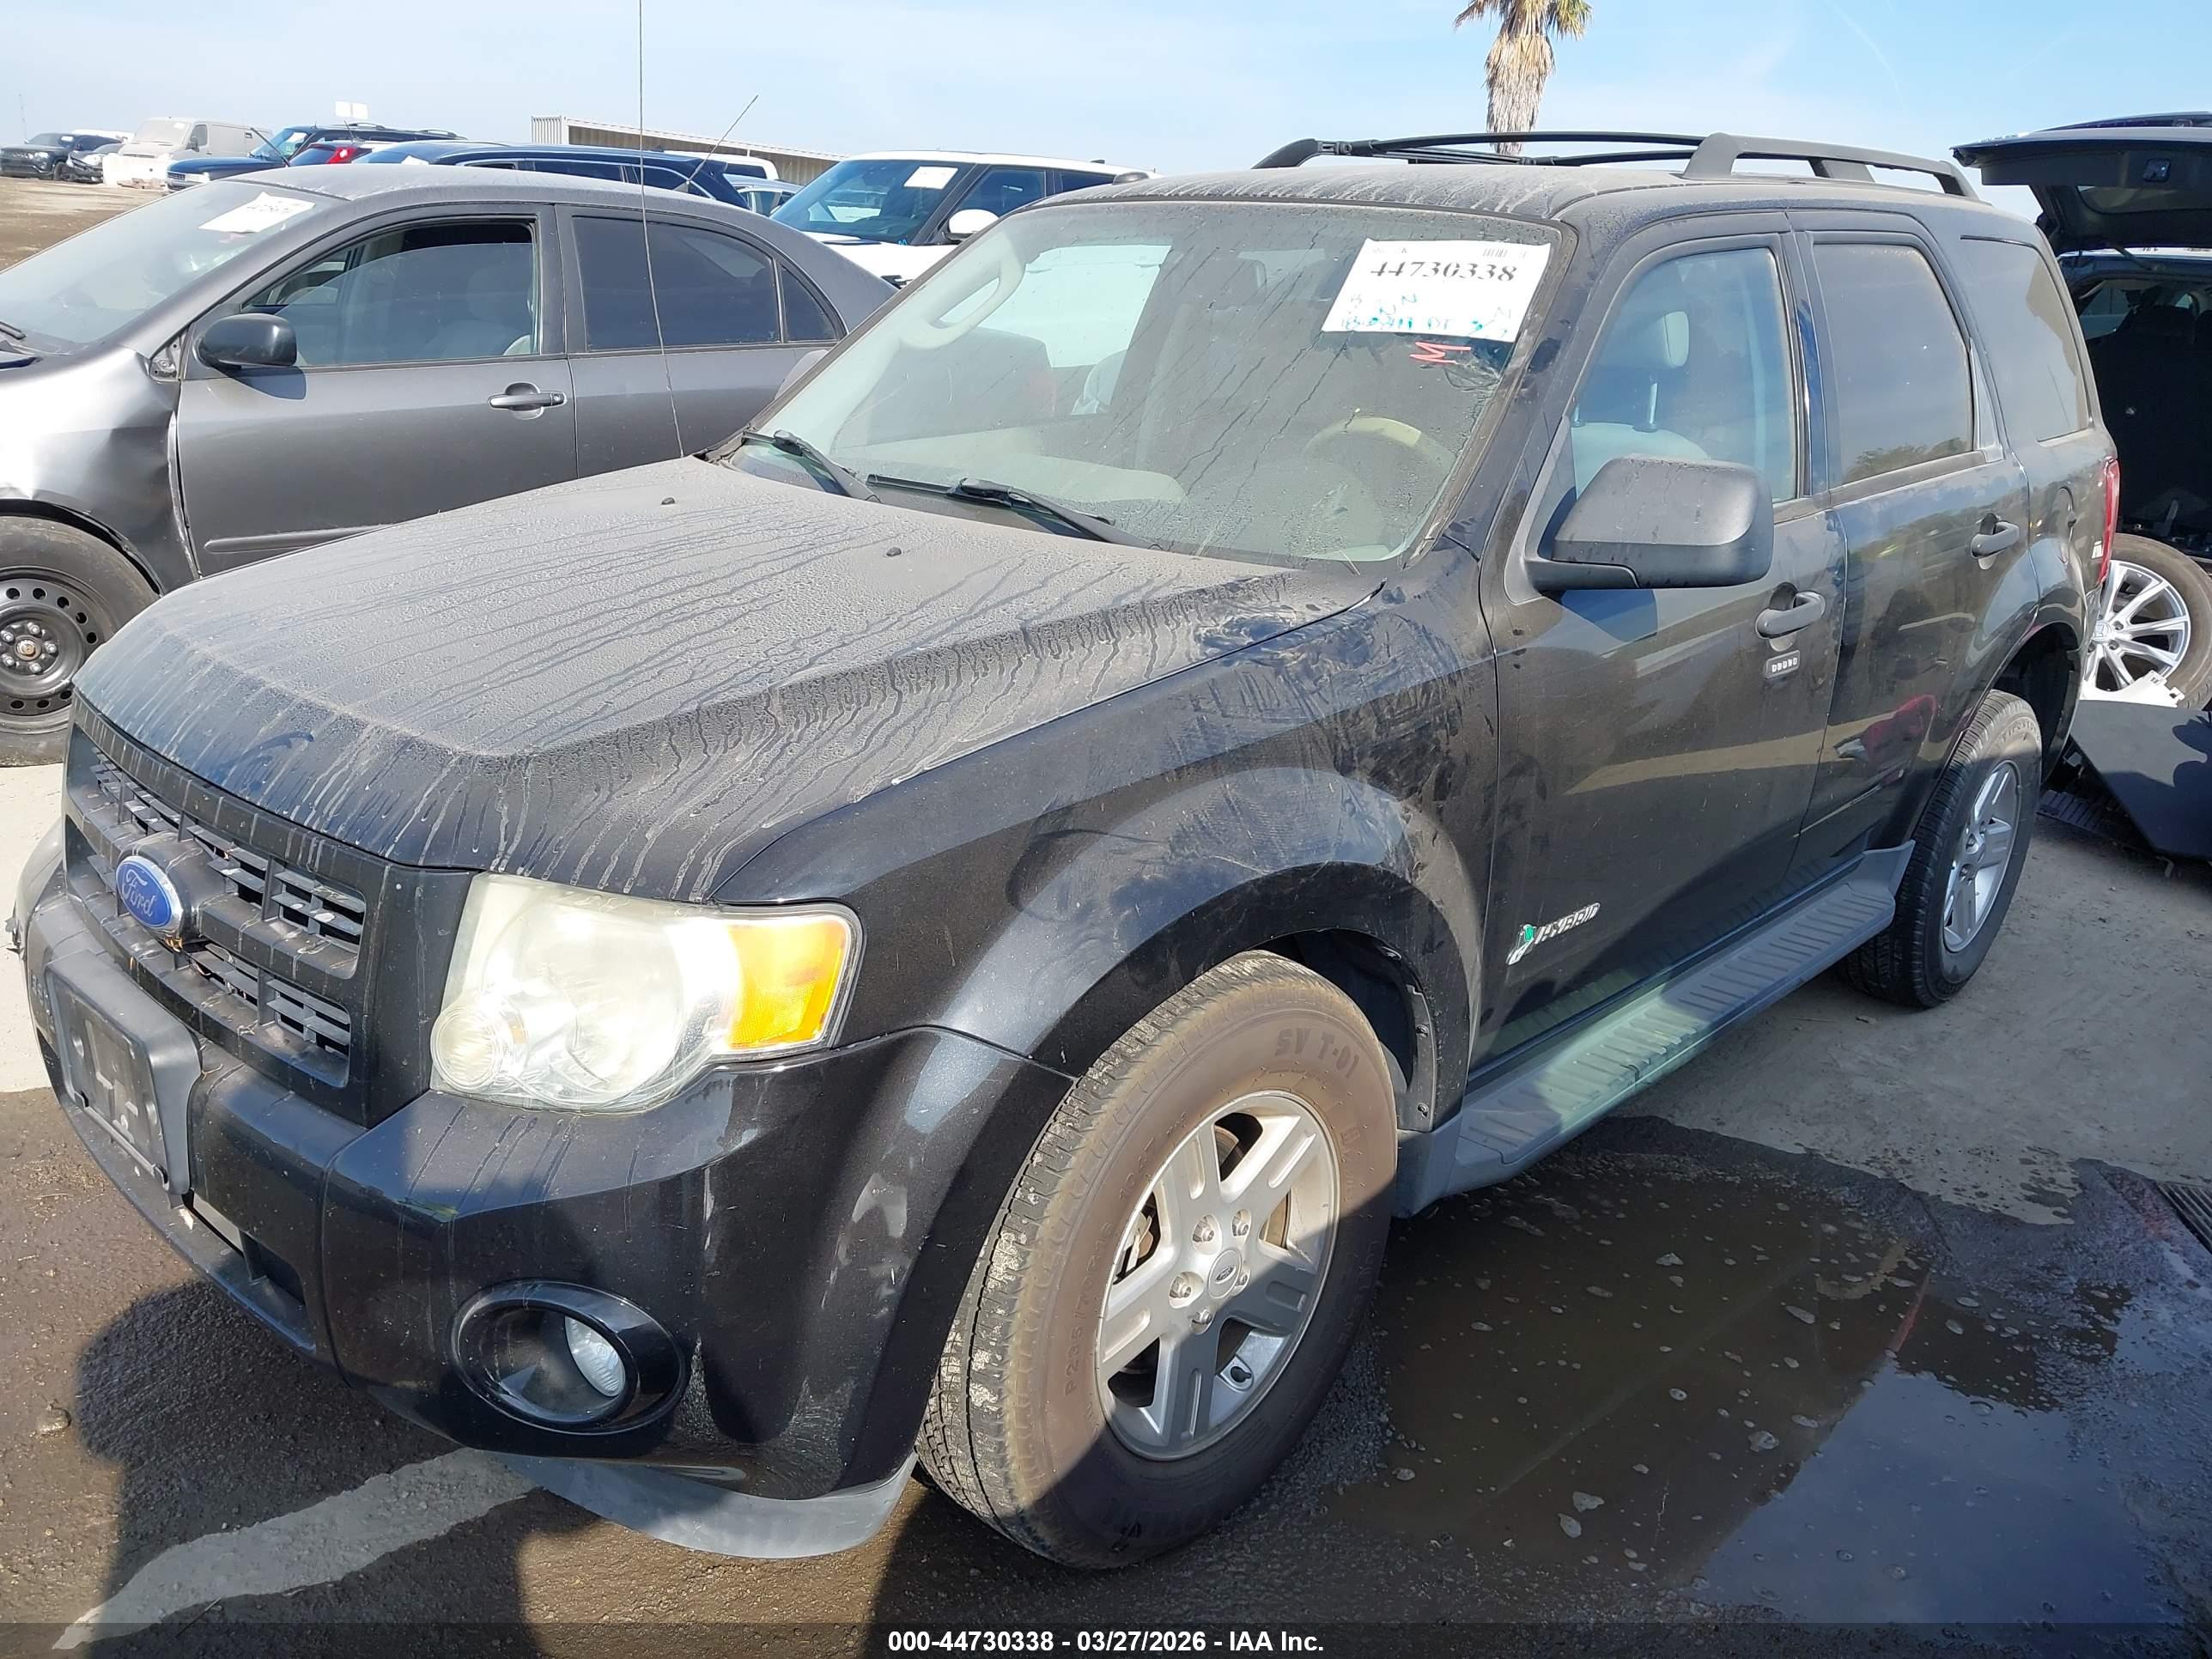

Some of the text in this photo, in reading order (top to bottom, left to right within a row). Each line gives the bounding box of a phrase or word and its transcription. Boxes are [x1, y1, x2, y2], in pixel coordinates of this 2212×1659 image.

[1370, 261, 1517, 282] 44730338
[122, 868, 156, 917] Ford
[1534, 902, 1601, 945] HYBRID
